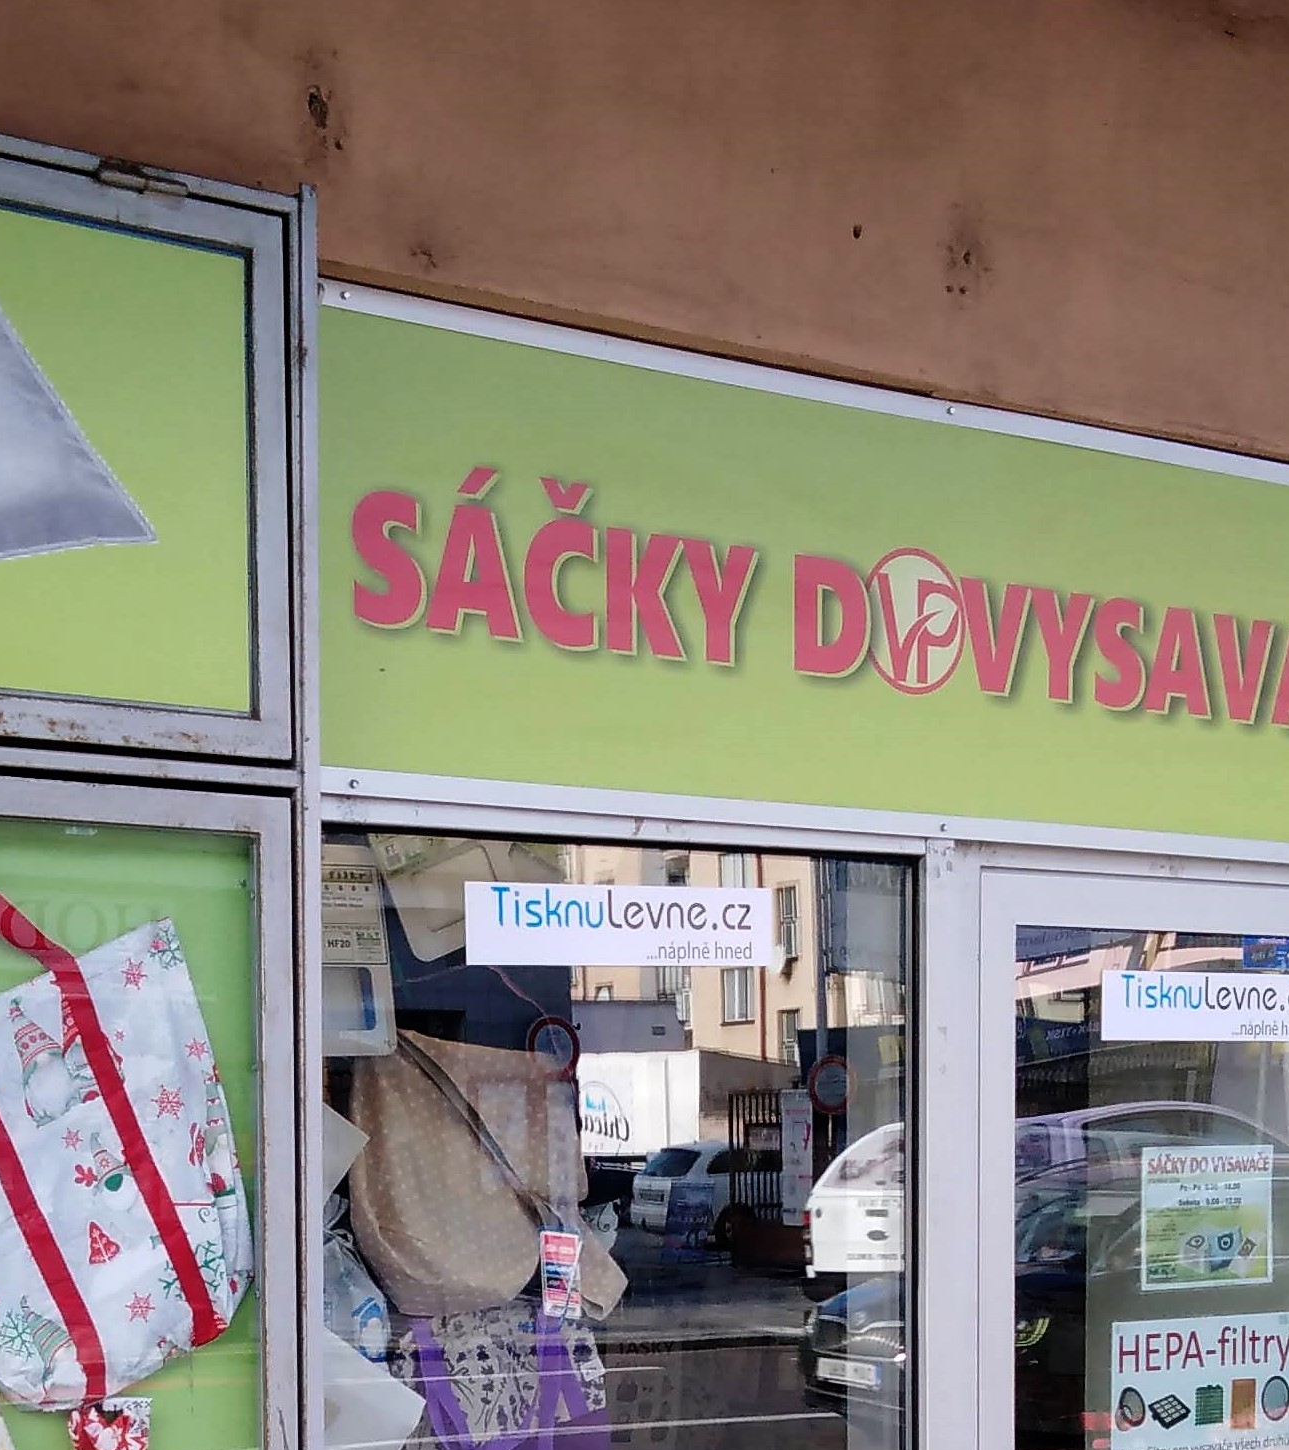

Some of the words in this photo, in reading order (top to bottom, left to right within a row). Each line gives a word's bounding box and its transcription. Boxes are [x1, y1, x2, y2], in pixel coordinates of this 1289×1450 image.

[351, 467, 758, 668] SÁČKY
[714, 941, 752, 960] hned
[1147, 1152, 1187, 1175] SÁČKY
[1190, 1156, 1208, 1174] DO
[1212, 1152, 1270, 1173] VYSAVAČE
